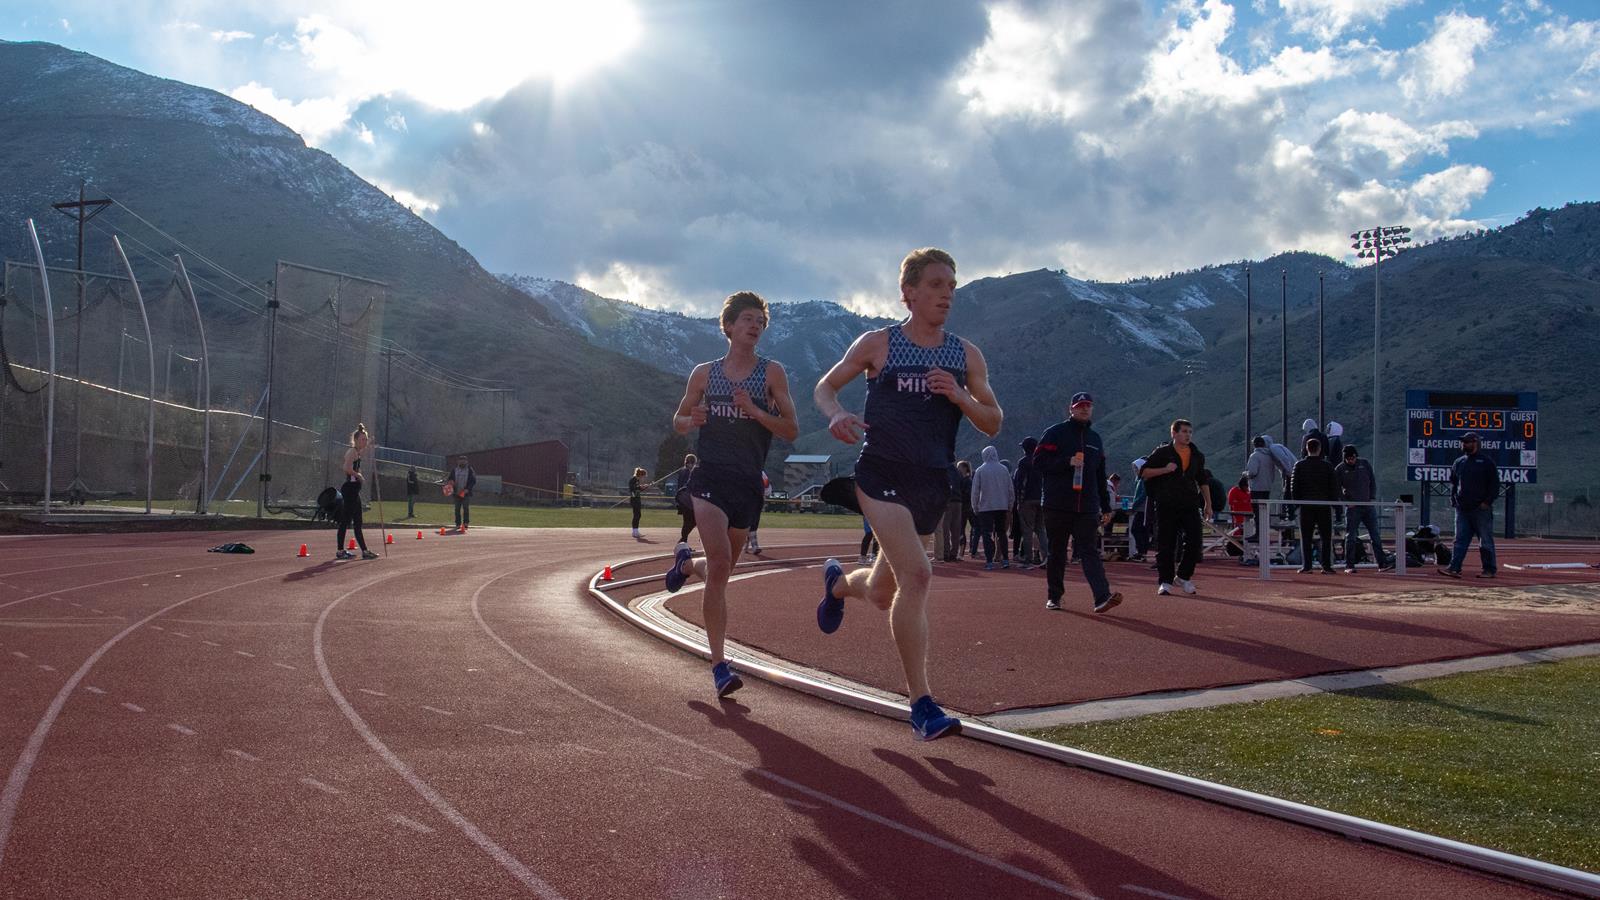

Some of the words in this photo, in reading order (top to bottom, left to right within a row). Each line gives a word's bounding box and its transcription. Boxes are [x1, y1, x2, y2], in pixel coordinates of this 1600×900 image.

[710, 404, 754, 420] MINE
[1410, 410, 1435, 419] HOME
[1510, 412, 1535, 421] GUEST
[1417, 439, 1442, 449] PLACE
[1443, 440, 1463, 449] EVEN
[1481, 441, 1501, 449] HEAT
[1505, 441, 1526, 450] LANE
[1498, 469, 1529, 483] RACK
